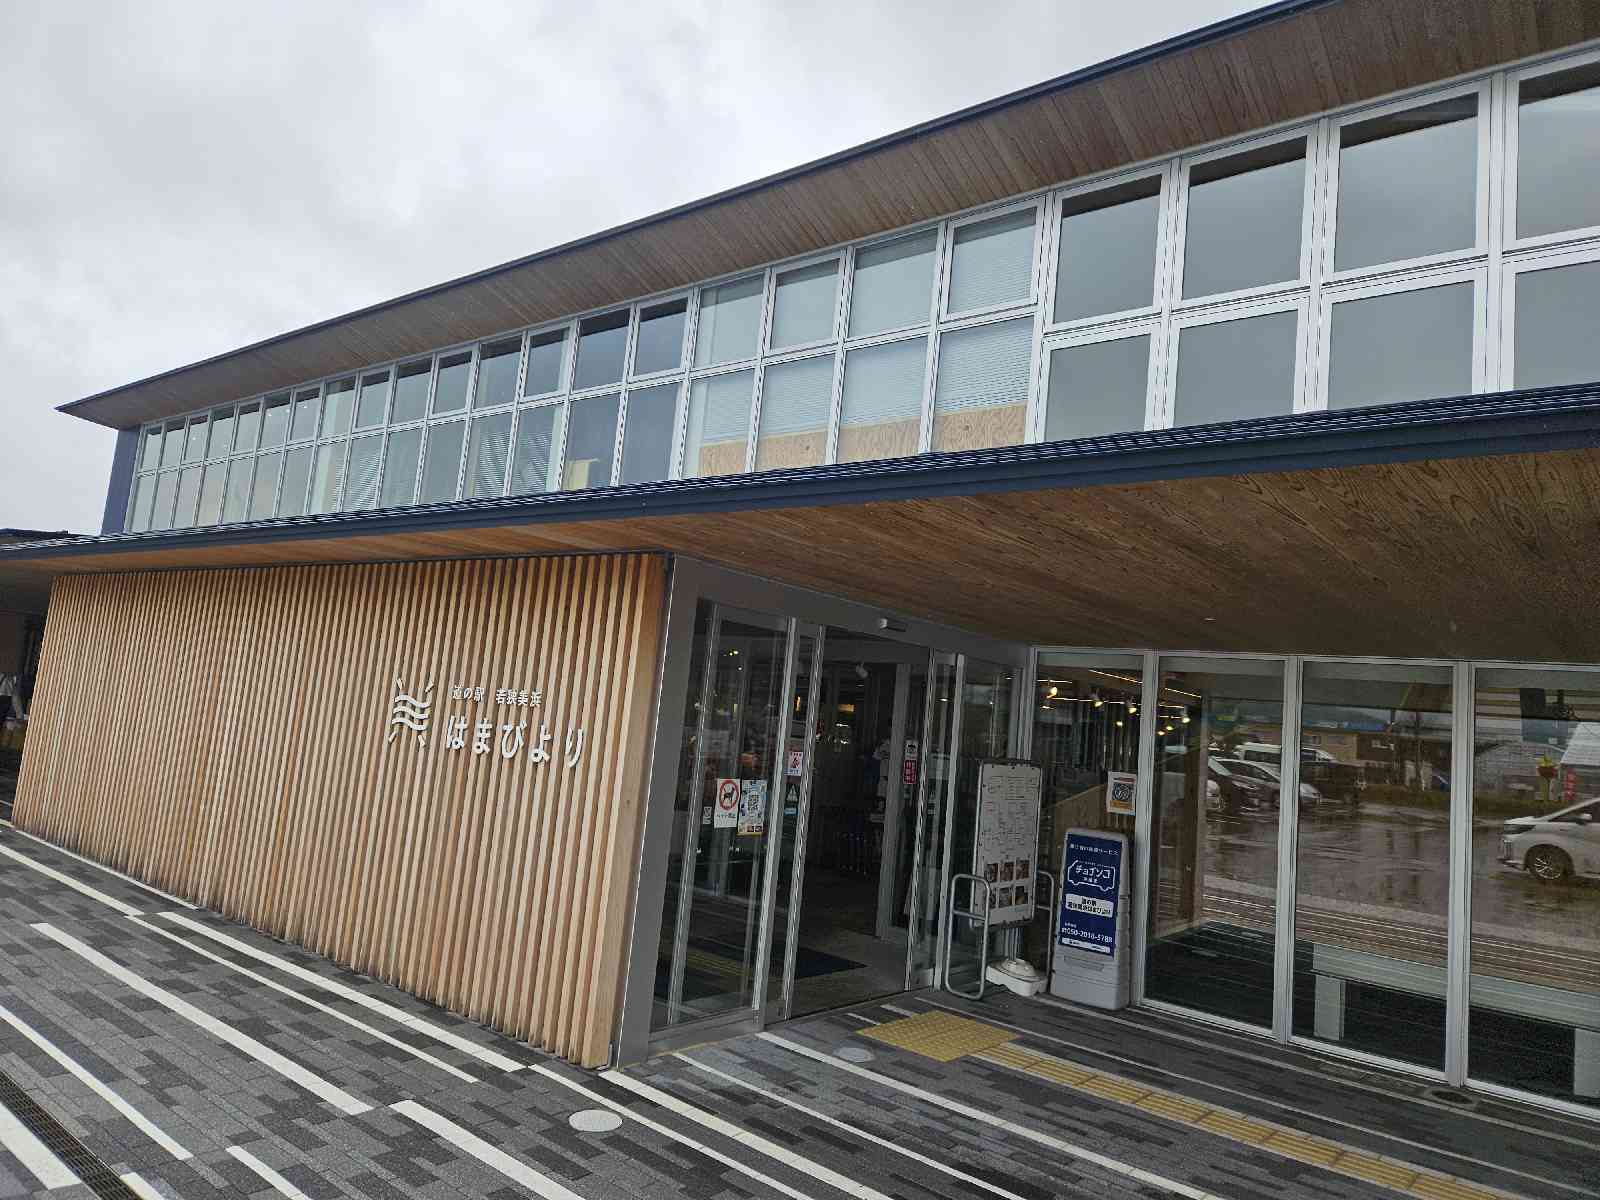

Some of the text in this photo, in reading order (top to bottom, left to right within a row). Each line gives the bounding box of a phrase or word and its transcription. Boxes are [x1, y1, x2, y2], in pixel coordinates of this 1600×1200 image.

[452, 682, 485, 702] 道の駅
[446, 715, 584, 768] はまびより
